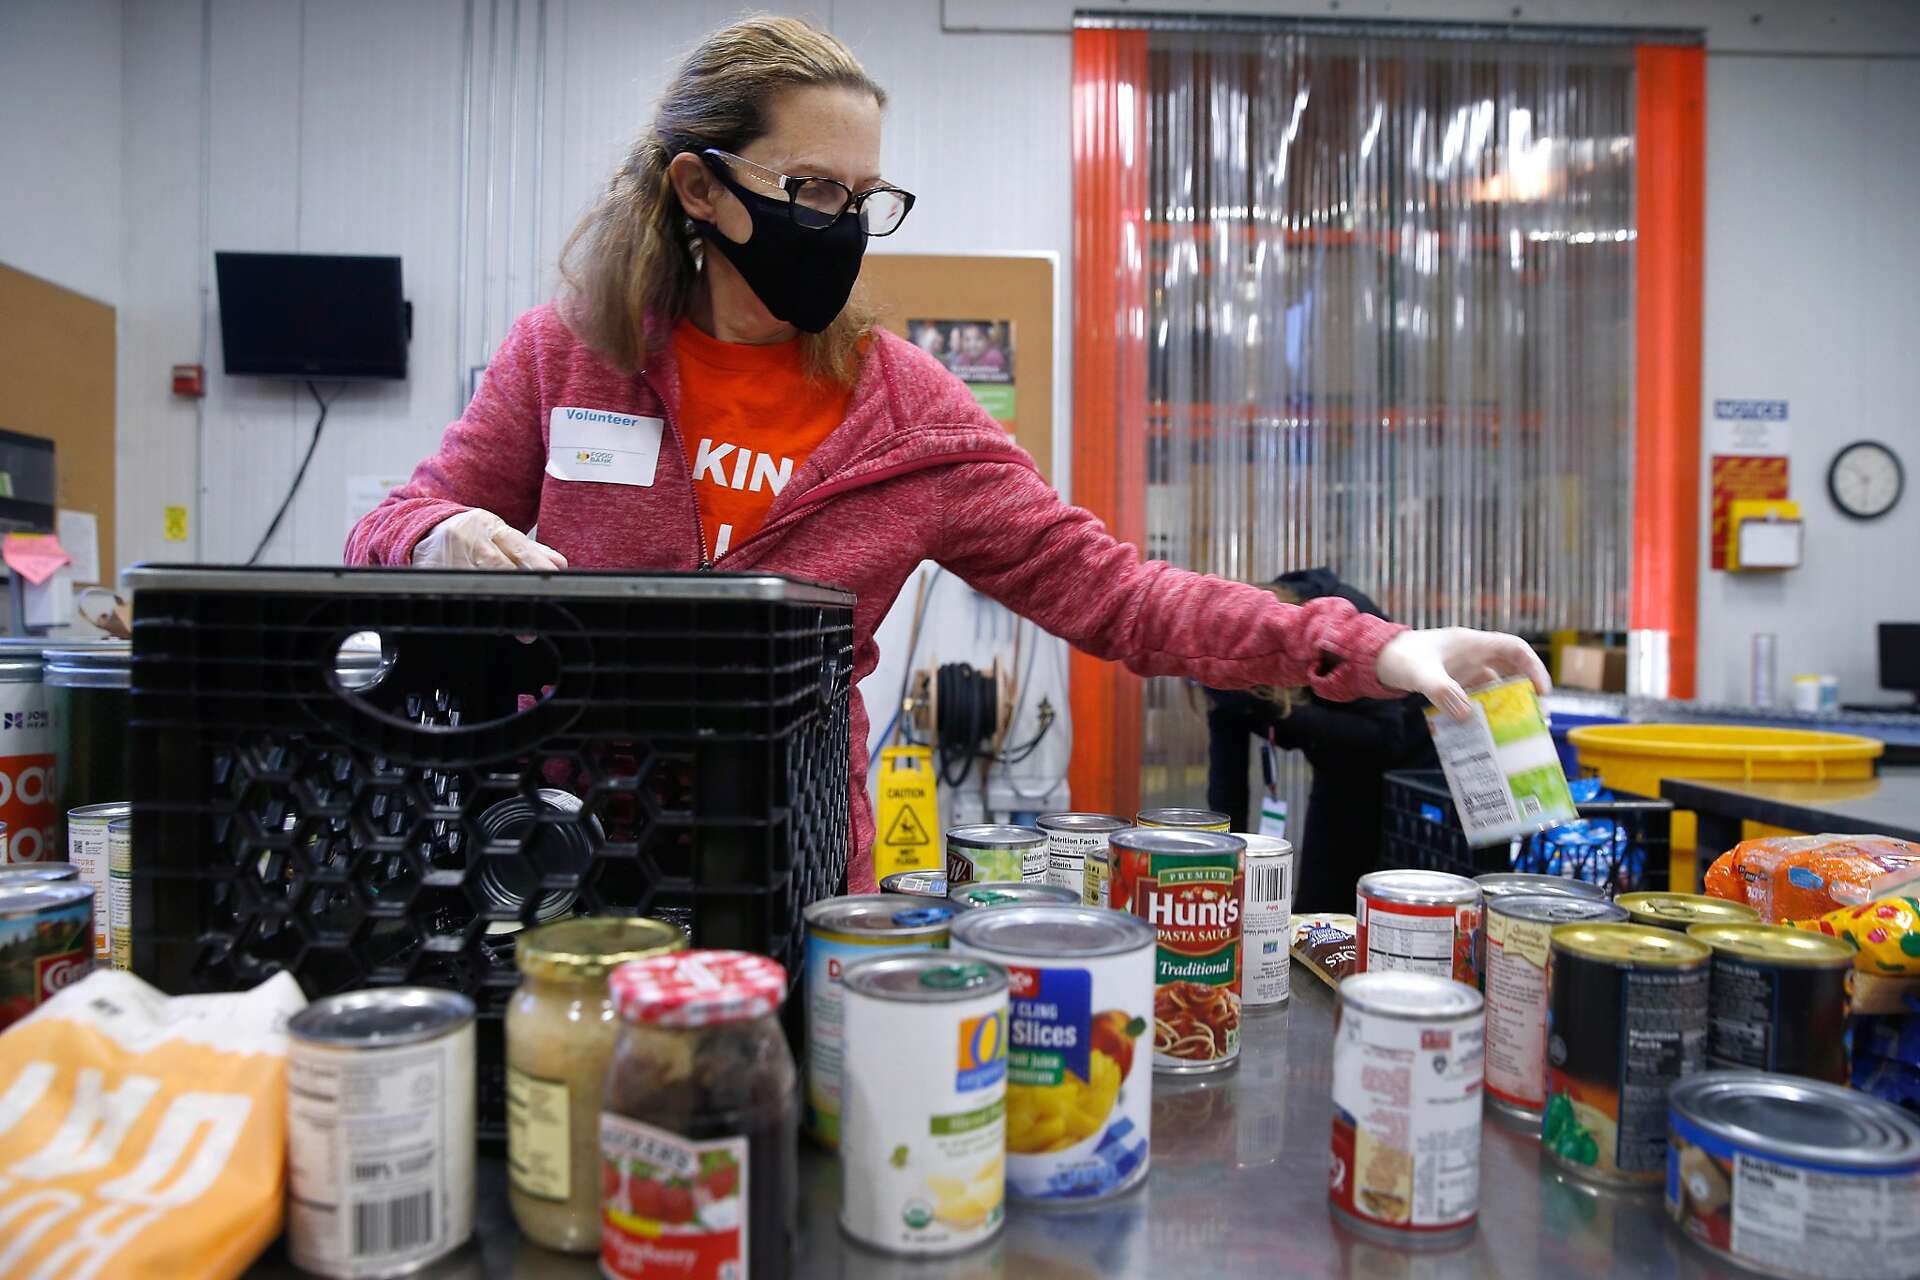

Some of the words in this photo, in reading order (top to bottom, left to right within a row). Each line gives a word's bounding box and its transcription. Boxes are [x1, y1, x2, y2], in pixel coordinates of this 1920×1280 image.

[566, 409, 639, 427] Volunteer
[1050, 835, 1078, 845] Nutrition
[1079, 838, 1100, 846] Facts
[1049, 860, 1073, 869] Calories
[1169, 872, 1227, 881] PREMIUM
[1149, 891, 1240, 927] Hunt's
[1157, 928, 1196, 943] PASTA
[1198, 928, 1232, 940] SAUCE
[1160, 958, 1230, 976] Traditional
[1018, 1002, 1058, 1020] CLING
[1012, 1020, 1077, 1047] Slices
[1629, 1029, 1680, 1041] Nutrition
[1740, 1155, 1798, 1181] Nutrition
